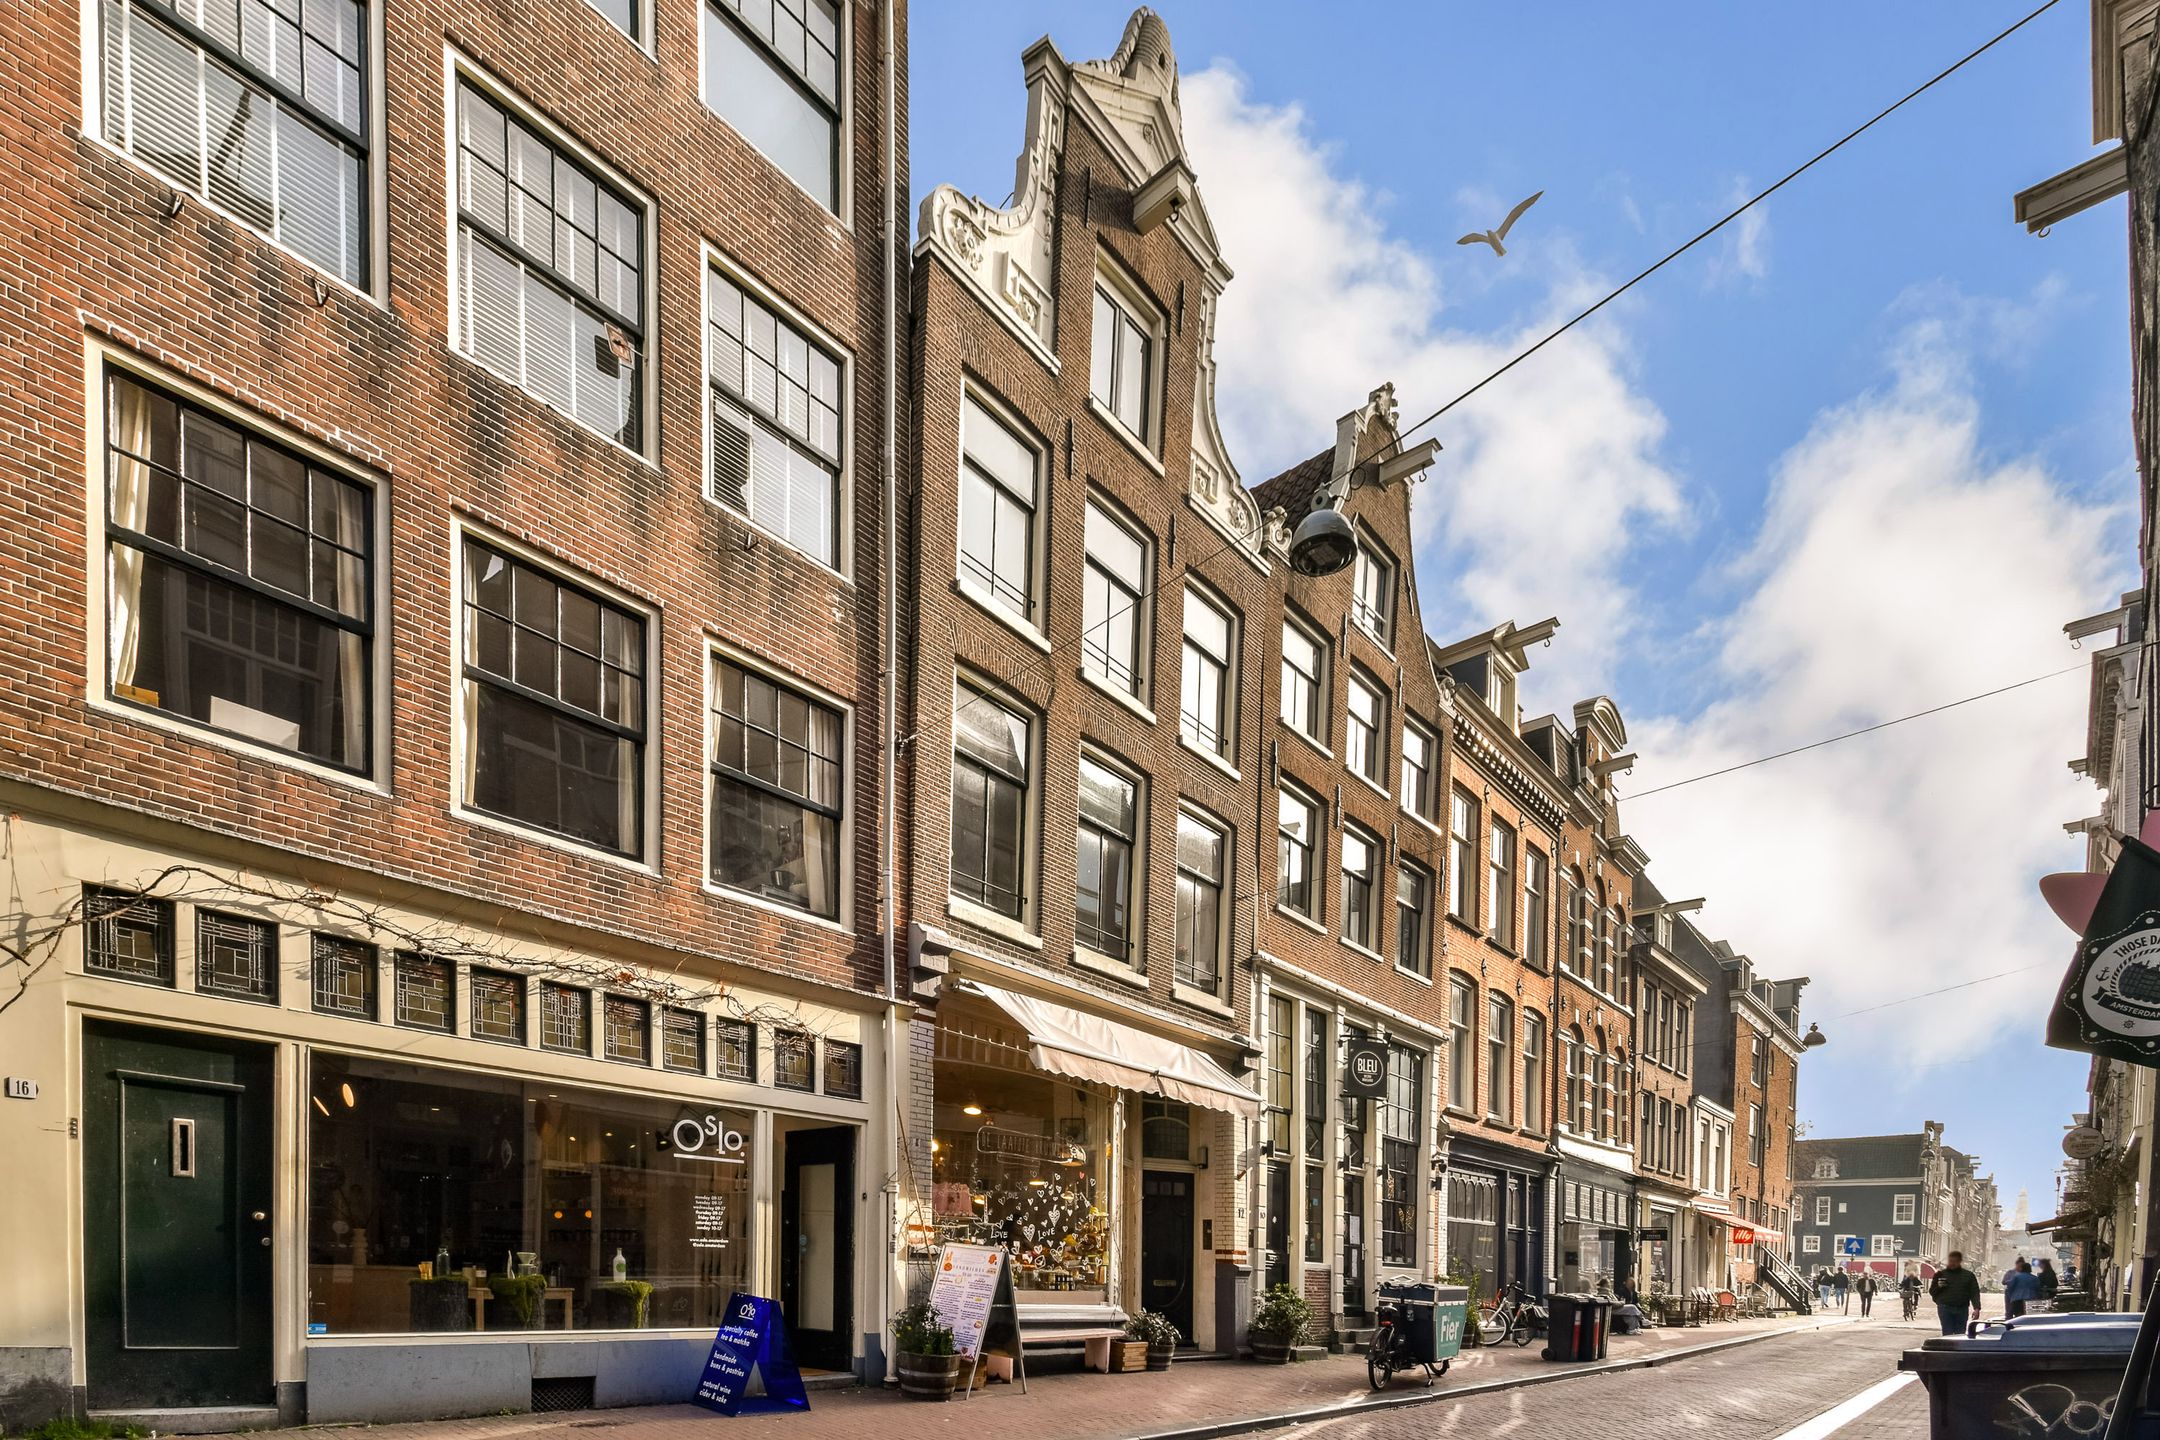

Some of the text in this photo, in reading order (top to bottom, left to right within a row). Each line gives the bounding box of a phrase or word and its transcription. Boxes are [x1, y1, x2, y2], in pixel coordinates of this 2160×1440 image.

[2113, 936, 2148, 958] THOSE
[1357, 1058, 1377, 1073] BLEU
[15, 1080, 29, 1095] 16
[1238, 1208, 1245, 1219] 12
[1735, 1230, 1753, 1242] illy
[724, 1325, 759, 1339] specialty coffee
[1441, 1312, 1460, 1343] Fier
[734, 1337, 750, 1347] matcha
[714, 1351, 737, 1365] handmade
[710, 1360, 721, 1370] buns
[726, 1366, 745, 1378] pastries
[703, 1381, 732, 1395] natural wine
[700, 1389, 712, 1399] cider
[716, 1394, 728, 1405] sake
